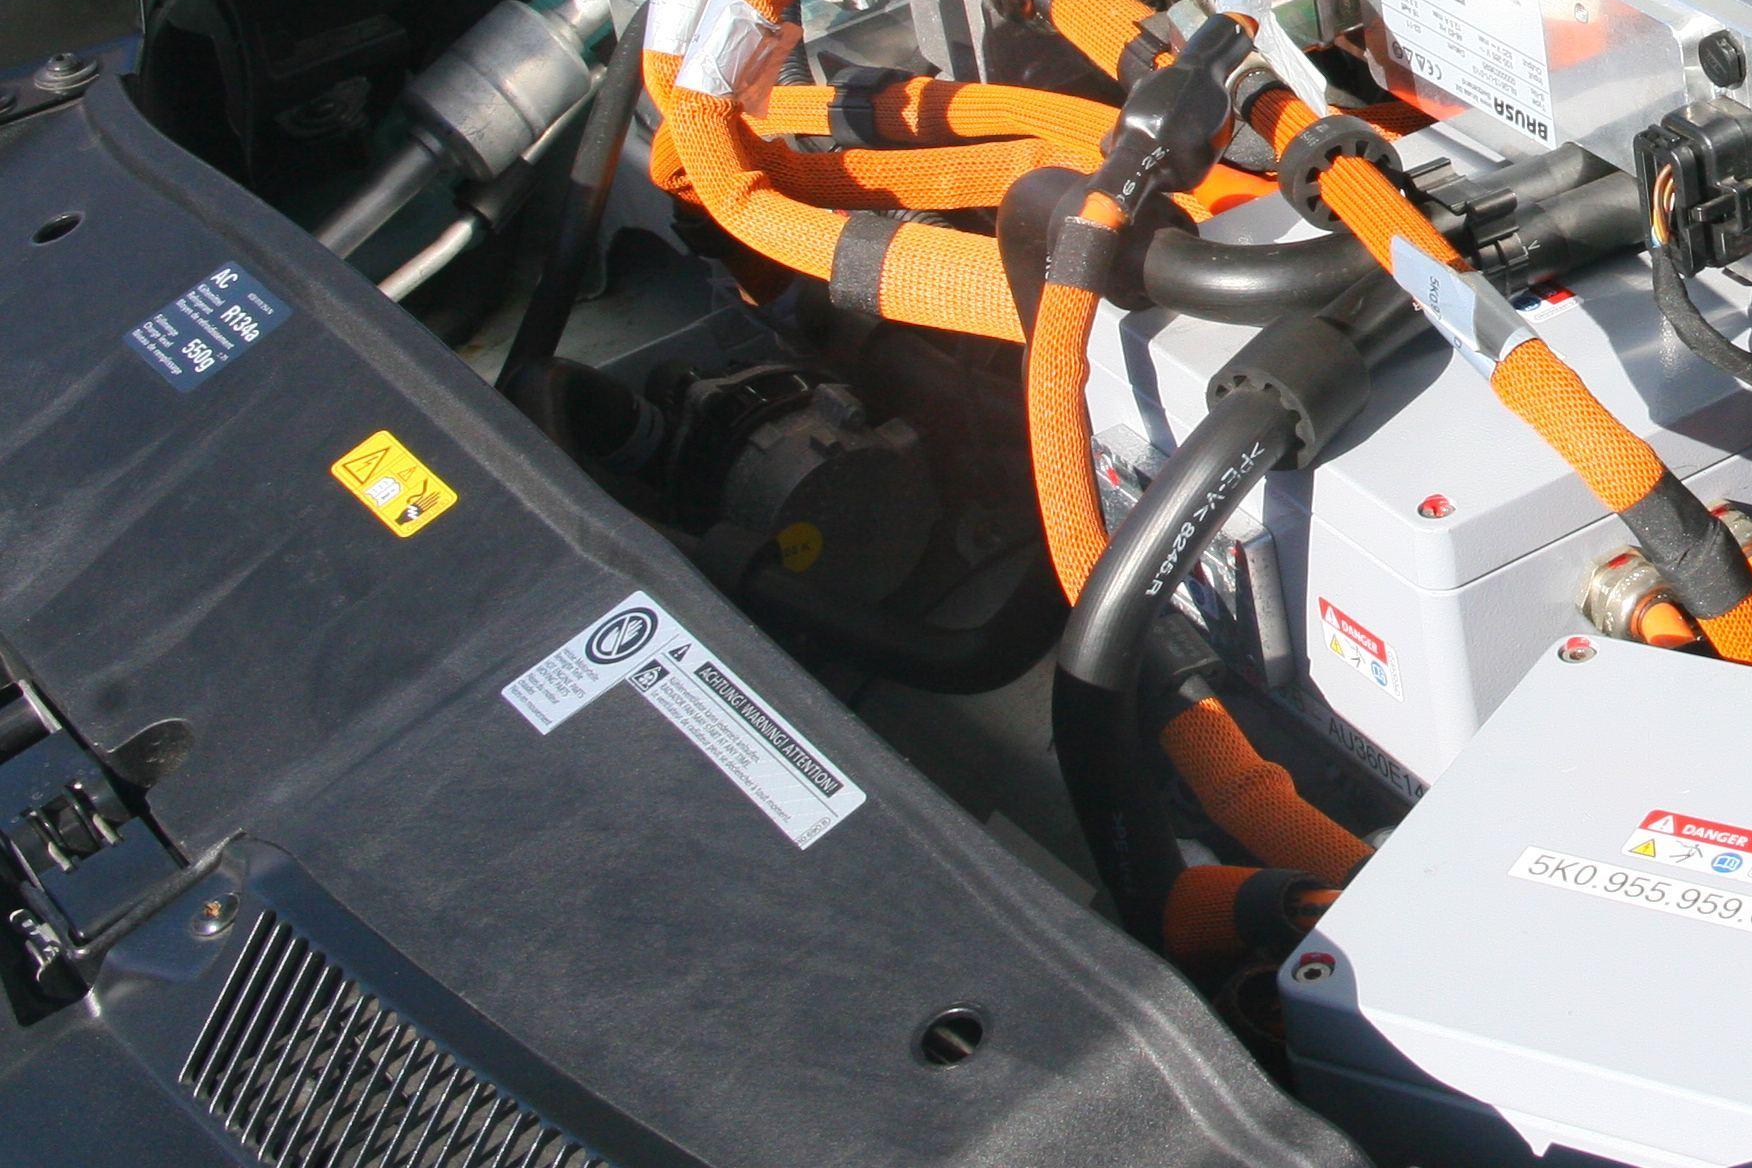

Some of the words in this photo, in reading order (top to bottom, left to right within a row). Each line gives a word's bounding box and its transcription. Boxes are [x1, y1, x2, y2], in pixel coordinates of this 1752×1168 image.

[1493, 97, 1548, 141] BRUSA
[210, 268, 239, 289] AC
[219, 304, 260, 343] R134a
[181, 338, 215, 373] 550g
[1341, 619, 1379, 654] DANGER
[699, 666, 750, 712] ACHTUNG!
[741, 705, 791, 751] WARNING!
[781, 743, 837, 794] ATTENTION!
[1681, 824, 1749, 848] DANGER
